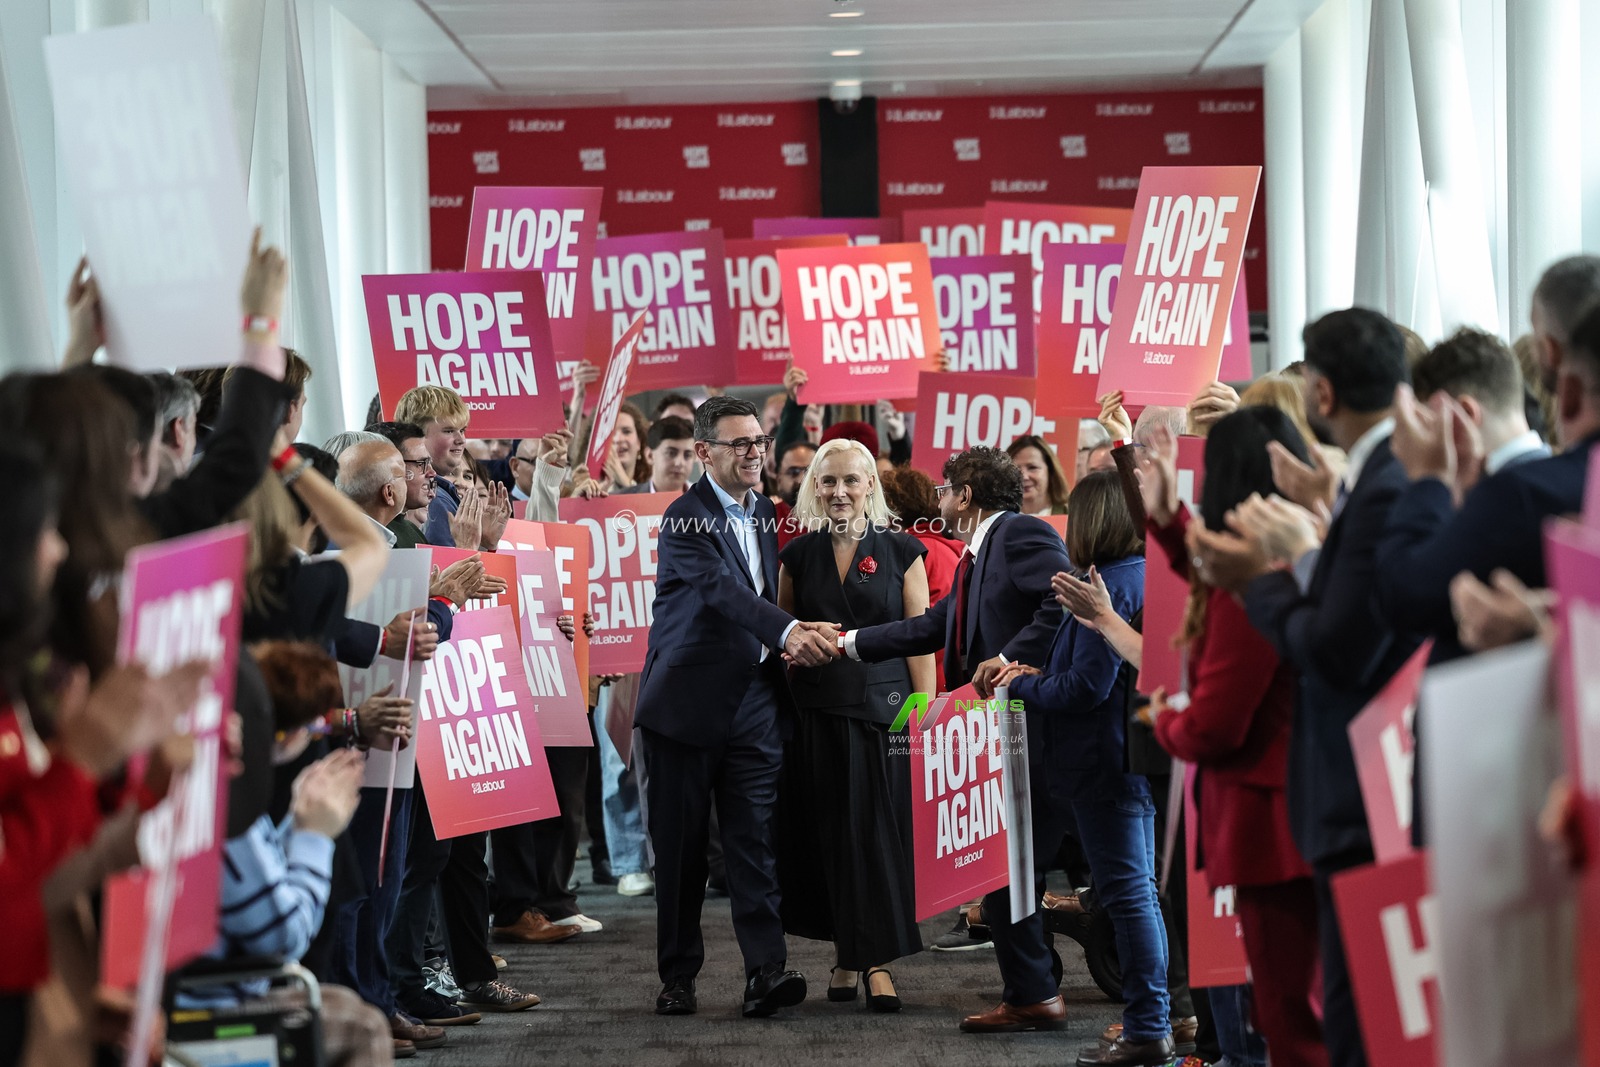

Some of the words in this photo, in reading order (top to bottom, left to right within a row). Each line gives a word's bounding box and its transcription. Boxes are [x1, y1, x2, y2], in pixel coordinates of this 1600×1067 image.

[482, 208, 585, 270] HOPE
[921, 224, 985, 258] HO
[1134, 195, 1239, 278] HOPE
[591, 249, 711, 311] HOPE
[725, 255, 781, 309] HO
[797, 261, 919, 321] HOPE
[932, 272, 1016, 329] OPE
[1061, 264, 1122, 325] HO
[387, 291, 531, 351] HOPE
[822, 317, 925, 364] AGAIN
[1129, 281, 1219, 347] AGAIN
[416, 352, 538, 397] AGAIN
[855, 365, 889, 375] Labour
[941, 328, 1017, 371] GAIN
[1149, 352, 1175, 365] Labour
[467, 401, 496, 410] abour
[575, 515, 663, 580] OPE
[598, 634, 633, 645] Labour
[419, 634, 517, 721] HOPE
[439, 711, 532, 781] AGAIN
[923, 699, 1003, 802] HOPE
[479, 779, 505, 793] Labour
[961, 849, 984, 867] Labour
